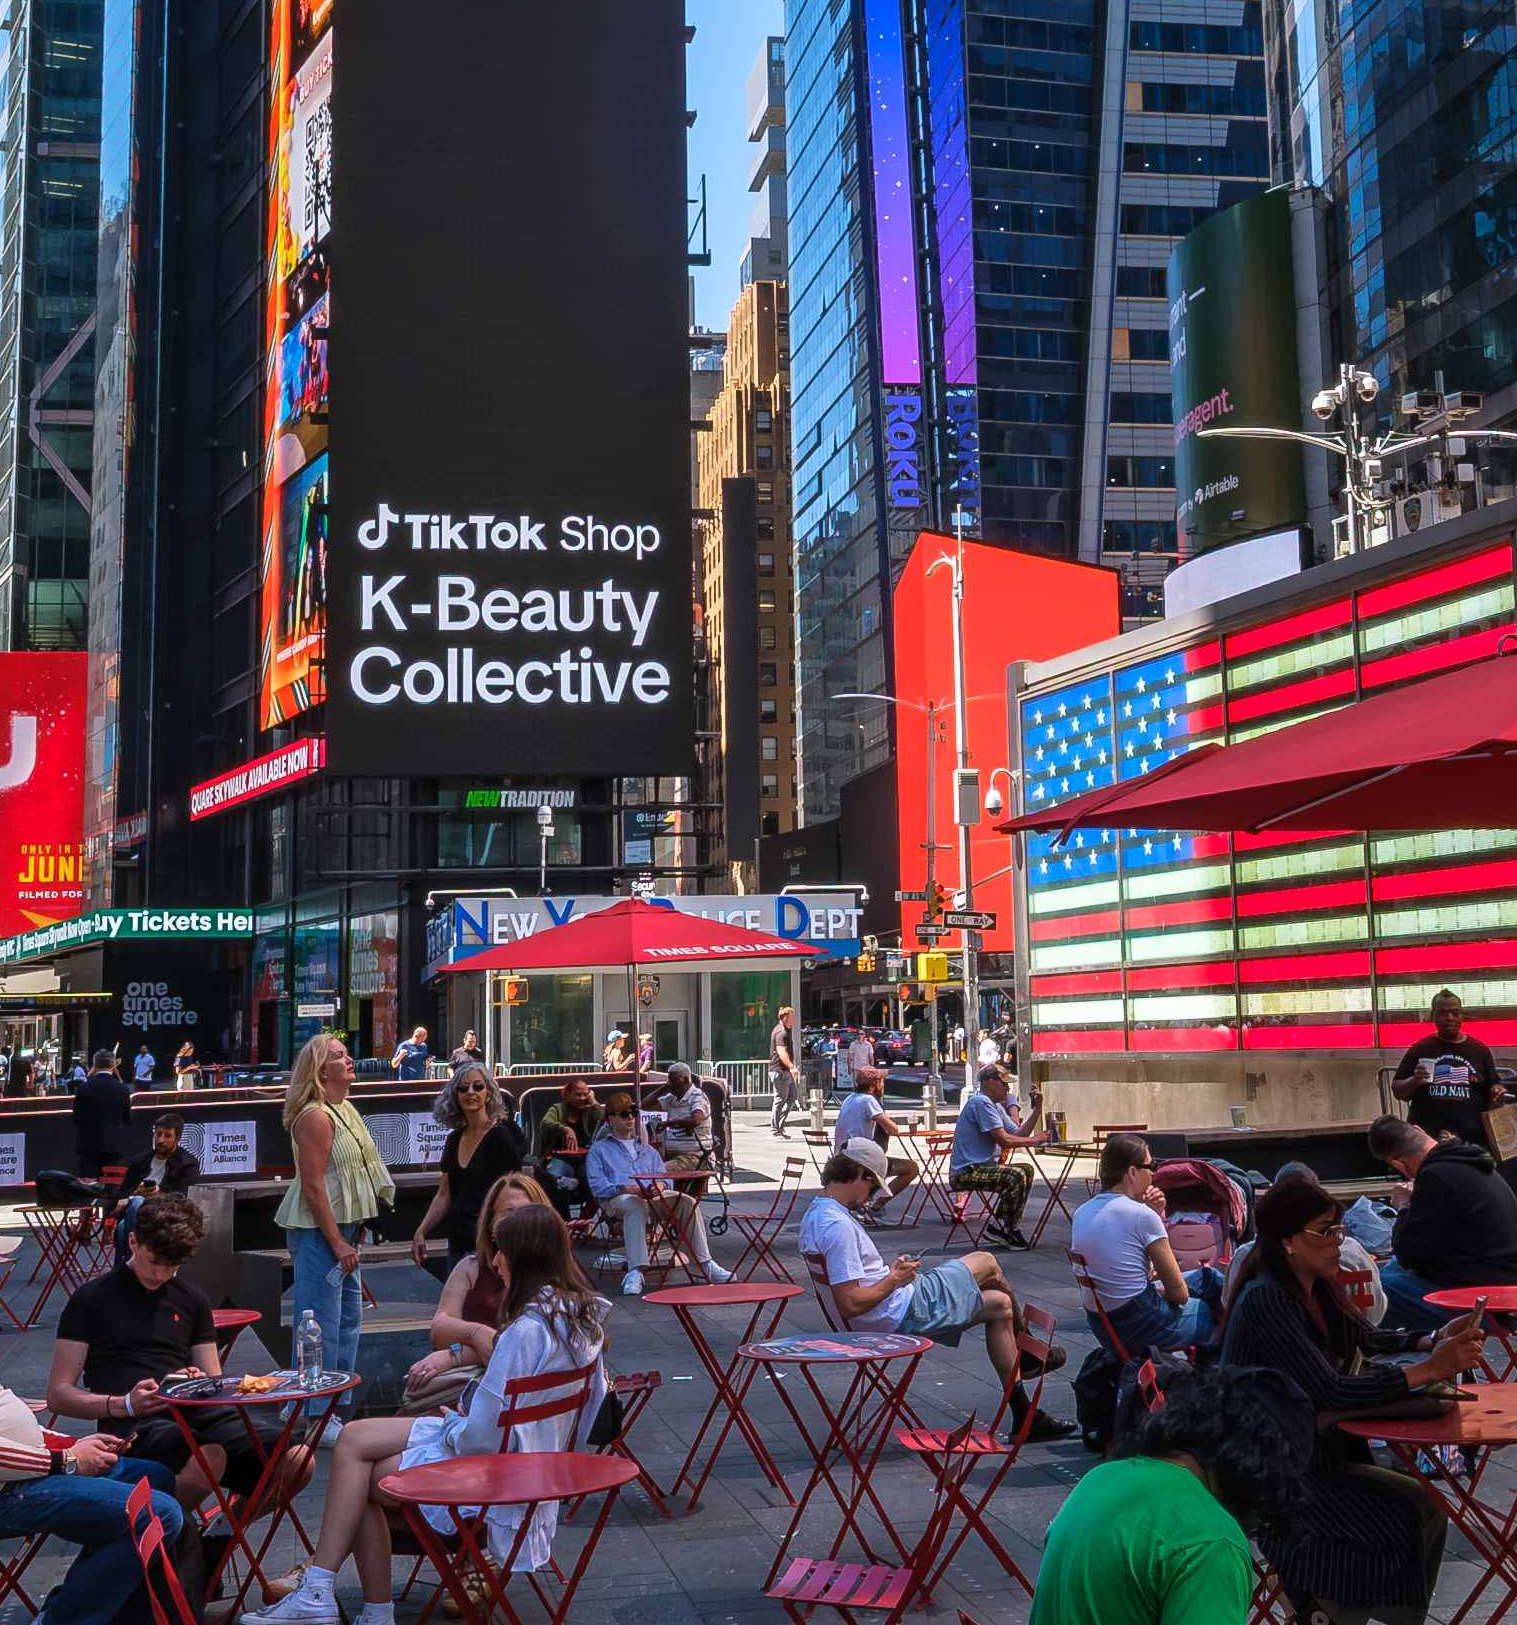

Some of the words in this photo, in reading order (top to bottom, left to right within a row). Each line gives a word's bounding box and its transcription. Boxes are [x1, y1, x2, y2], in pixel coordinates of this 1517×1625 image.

[886, 395, 922, 507] ROKU
[1204, 475, 1239, 501] Airtable
[404, 513, 546, 552] TikTok
[559, 516, 660, 560] Shop
[360, 575, 660, 647] K-Beauty
[350, 646, 670, 705] Collective
[214, 774, 247, 805] SKYWALK
[248, 759, 287, 793] AVAILABLE
[287, 745, 309, 778] NOW
[21, 844, 50, 855] ONLY
[18, 890, 59, 901] FILMED
[128, 911, 211, 932] Tickets
[456, 899, 539, 946] NEW
[777, 896, 864, 940] DEPT
[644, 945, 709, 957] TIMES
[711, 941, 798, 954] SQUARE
[126, 982, 168, 996] one
[123, 993, 184, 1010] times
[122, 1010, 198, 1031] square
[1429, 1085, 1447, 1097] OLD
[1449, 1085, 1471, 1099] NAVY
[214, 1133, 246, 1143] Times
[416, 1133, 447, 1143] Squar
[212, 1143, 249, 1155] Square
[213, 1155, 247, 1164] Alliance
